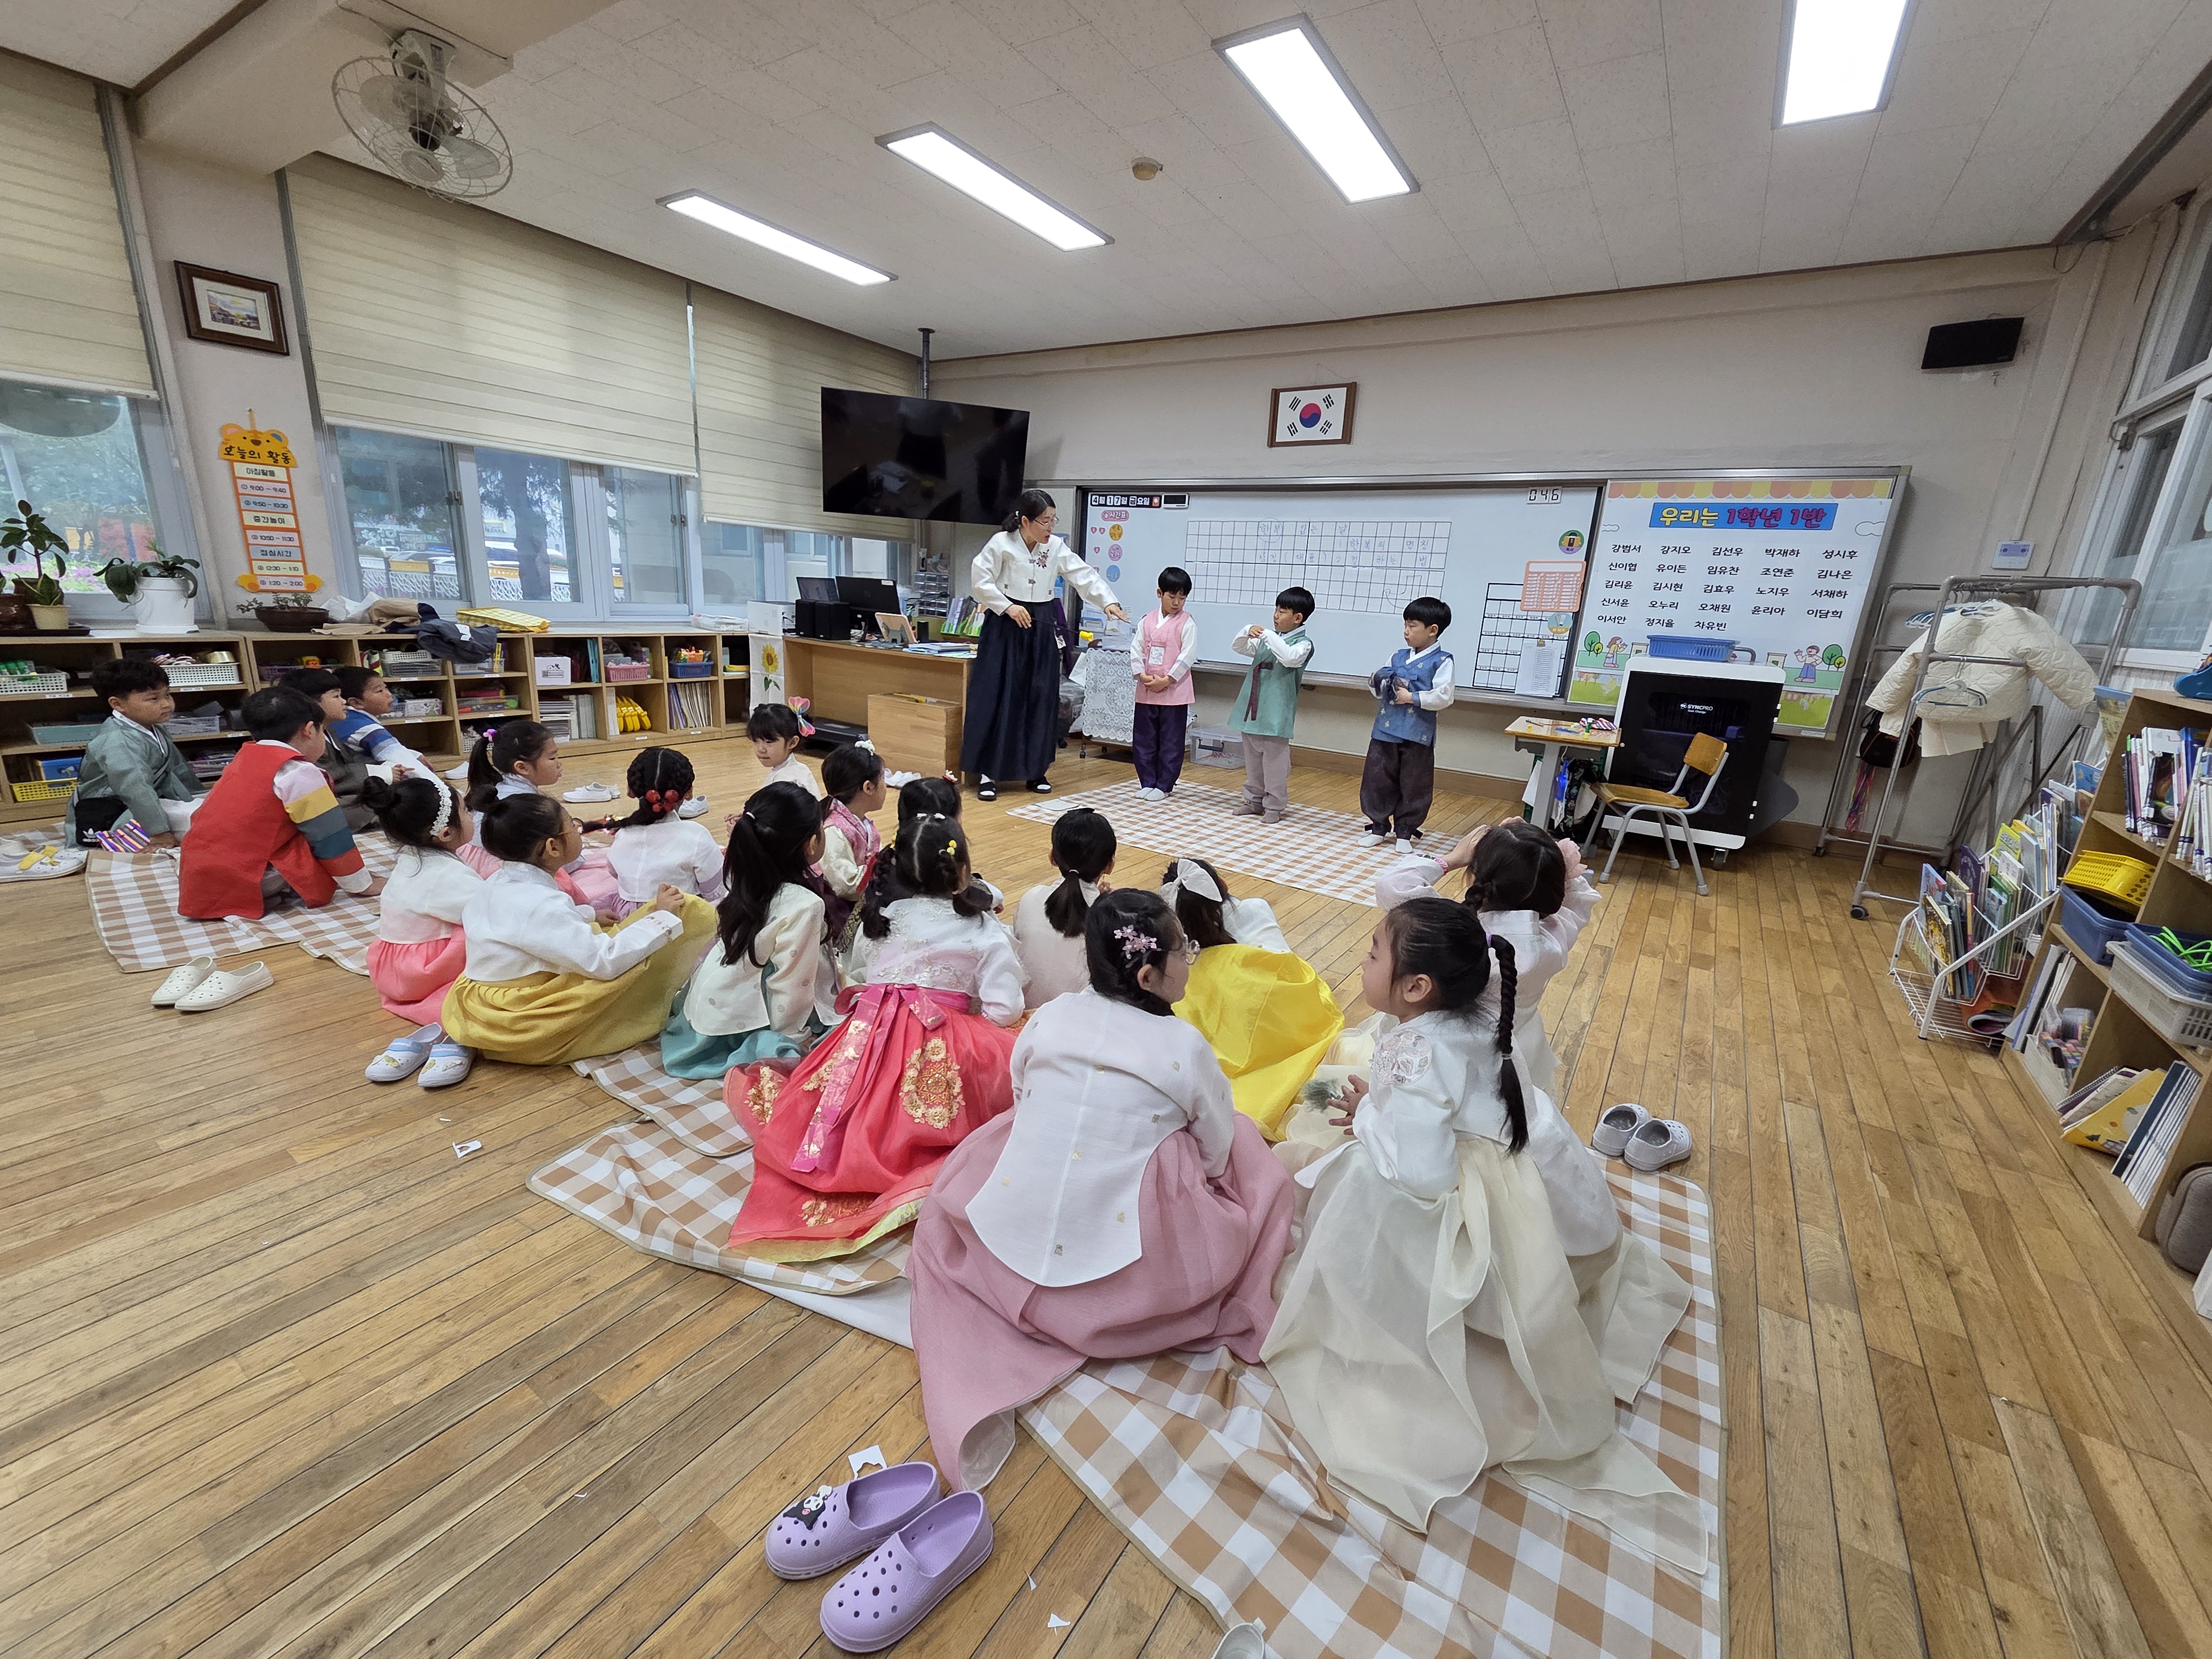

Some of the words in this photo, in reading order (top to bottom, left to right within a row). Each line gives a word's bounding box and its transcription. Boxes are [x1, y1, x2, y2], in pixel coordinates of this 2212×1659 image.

[223, 445, 260, 459] 오늘의
[267, 451, 291, 464] 활동
[1107, 495, 1128, 504] 17일
[1129, 496, 1150, 506] 금요일
[1660, 507, 1719, 527] 우리는
[1727, 507, 1783, 528] 1학년
[1790, 508, 1827, 529] 1반
[1260, 524, 1280, 535] 한복
[1611, 544, 1641, 553] 강범서
[1661, 546, 1691, 555] 강지오
[1712, 547, 1744, 556] 김선우
[1765, 548, 1800, 557] 박재하
[1823, 550, 1858, 560] 성시후
[1608, 562, 1637, 572] 신이협
[1656, 564, 1687, 573] 유이든
[1707, 566, 1740, 575] 임유찬
[1760, 568, 1794, 577] 조연준
[1817, 570, 1853, 580] 김나은
[1605, 580, 1633, 589] 김리윤
[1653, 582, 1683, 592] 김시현
[1703, 585, 1734, 594] 김효우
[1756, 587, 1790, 596] 노지우
[1811, 589, 1848, 599] 서채하
[1601, 598, 1630, 607] 신서윤
[1648, 601, 1678, 609] 오누리
[1698, 603, 1731, 613] 오채원
[1751, 606, 1785, 615] 윤리아
[1807, 609, 1843, 619] 이담희
[1598, 615, 1626, 624] 이서안
[1694, 621, 1726, 631] 차유빈
